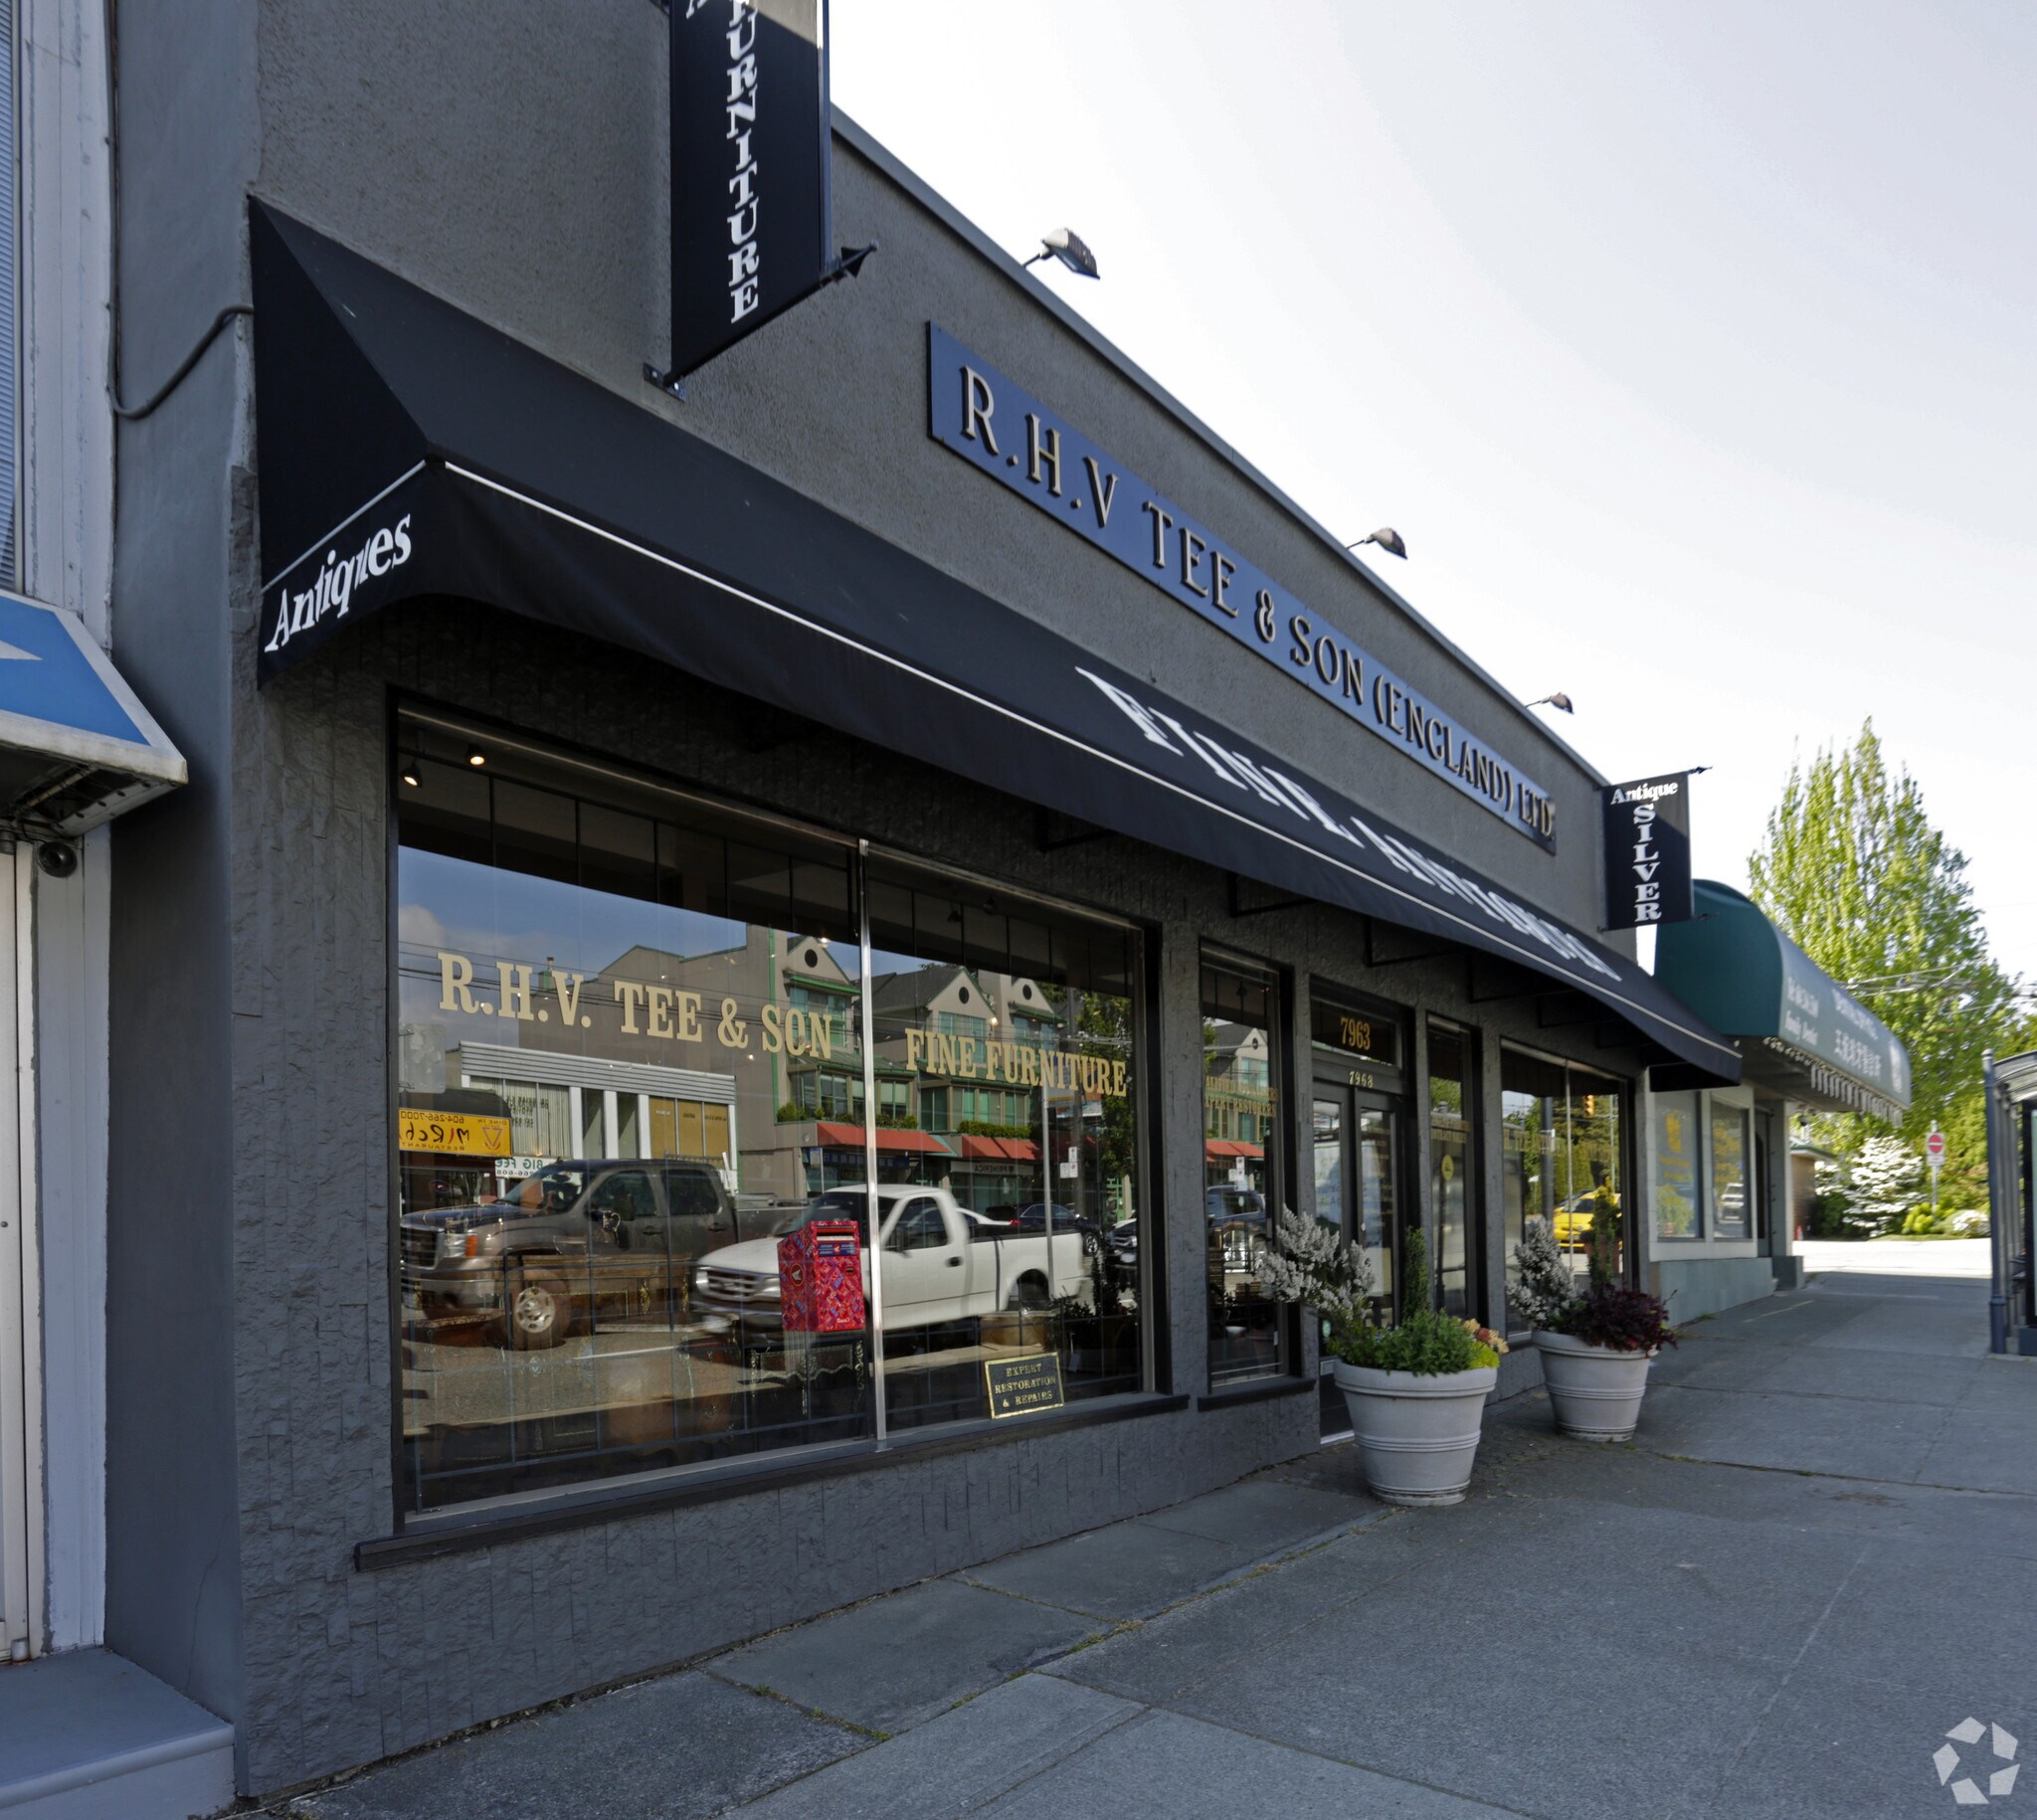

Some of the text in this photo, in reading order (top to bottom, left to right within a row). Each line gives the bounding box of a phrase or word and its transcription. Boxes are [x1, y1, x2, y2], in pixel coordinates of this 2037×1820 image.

[265, 513, 412, 652] Antiques
[1143, 500, 1238, 618] TEE
[1255, 589, 1276, 643] &
[1289, 615, 1365, 705] SON
[1374, 674, 1514, 813] (ENGLAND)
[1075, 665, 1365, 849] FINE
[1610, 782, 1679, 805] Antique
[1632, 803, 1662, 923] SILVER
[437, 952, 832, 1060] R.H.V. TEE & SON
[1340, 1016, 1371, 1050] 7963
[905, 1027, 1127, 1097] FINE FURNITURE
[995, 1376, 1056, 1394] RESTORATION
[1003, 1390, 1053, 1408] & REPAIRS
[1006, 1364, 1042, 1377] EXPERT
